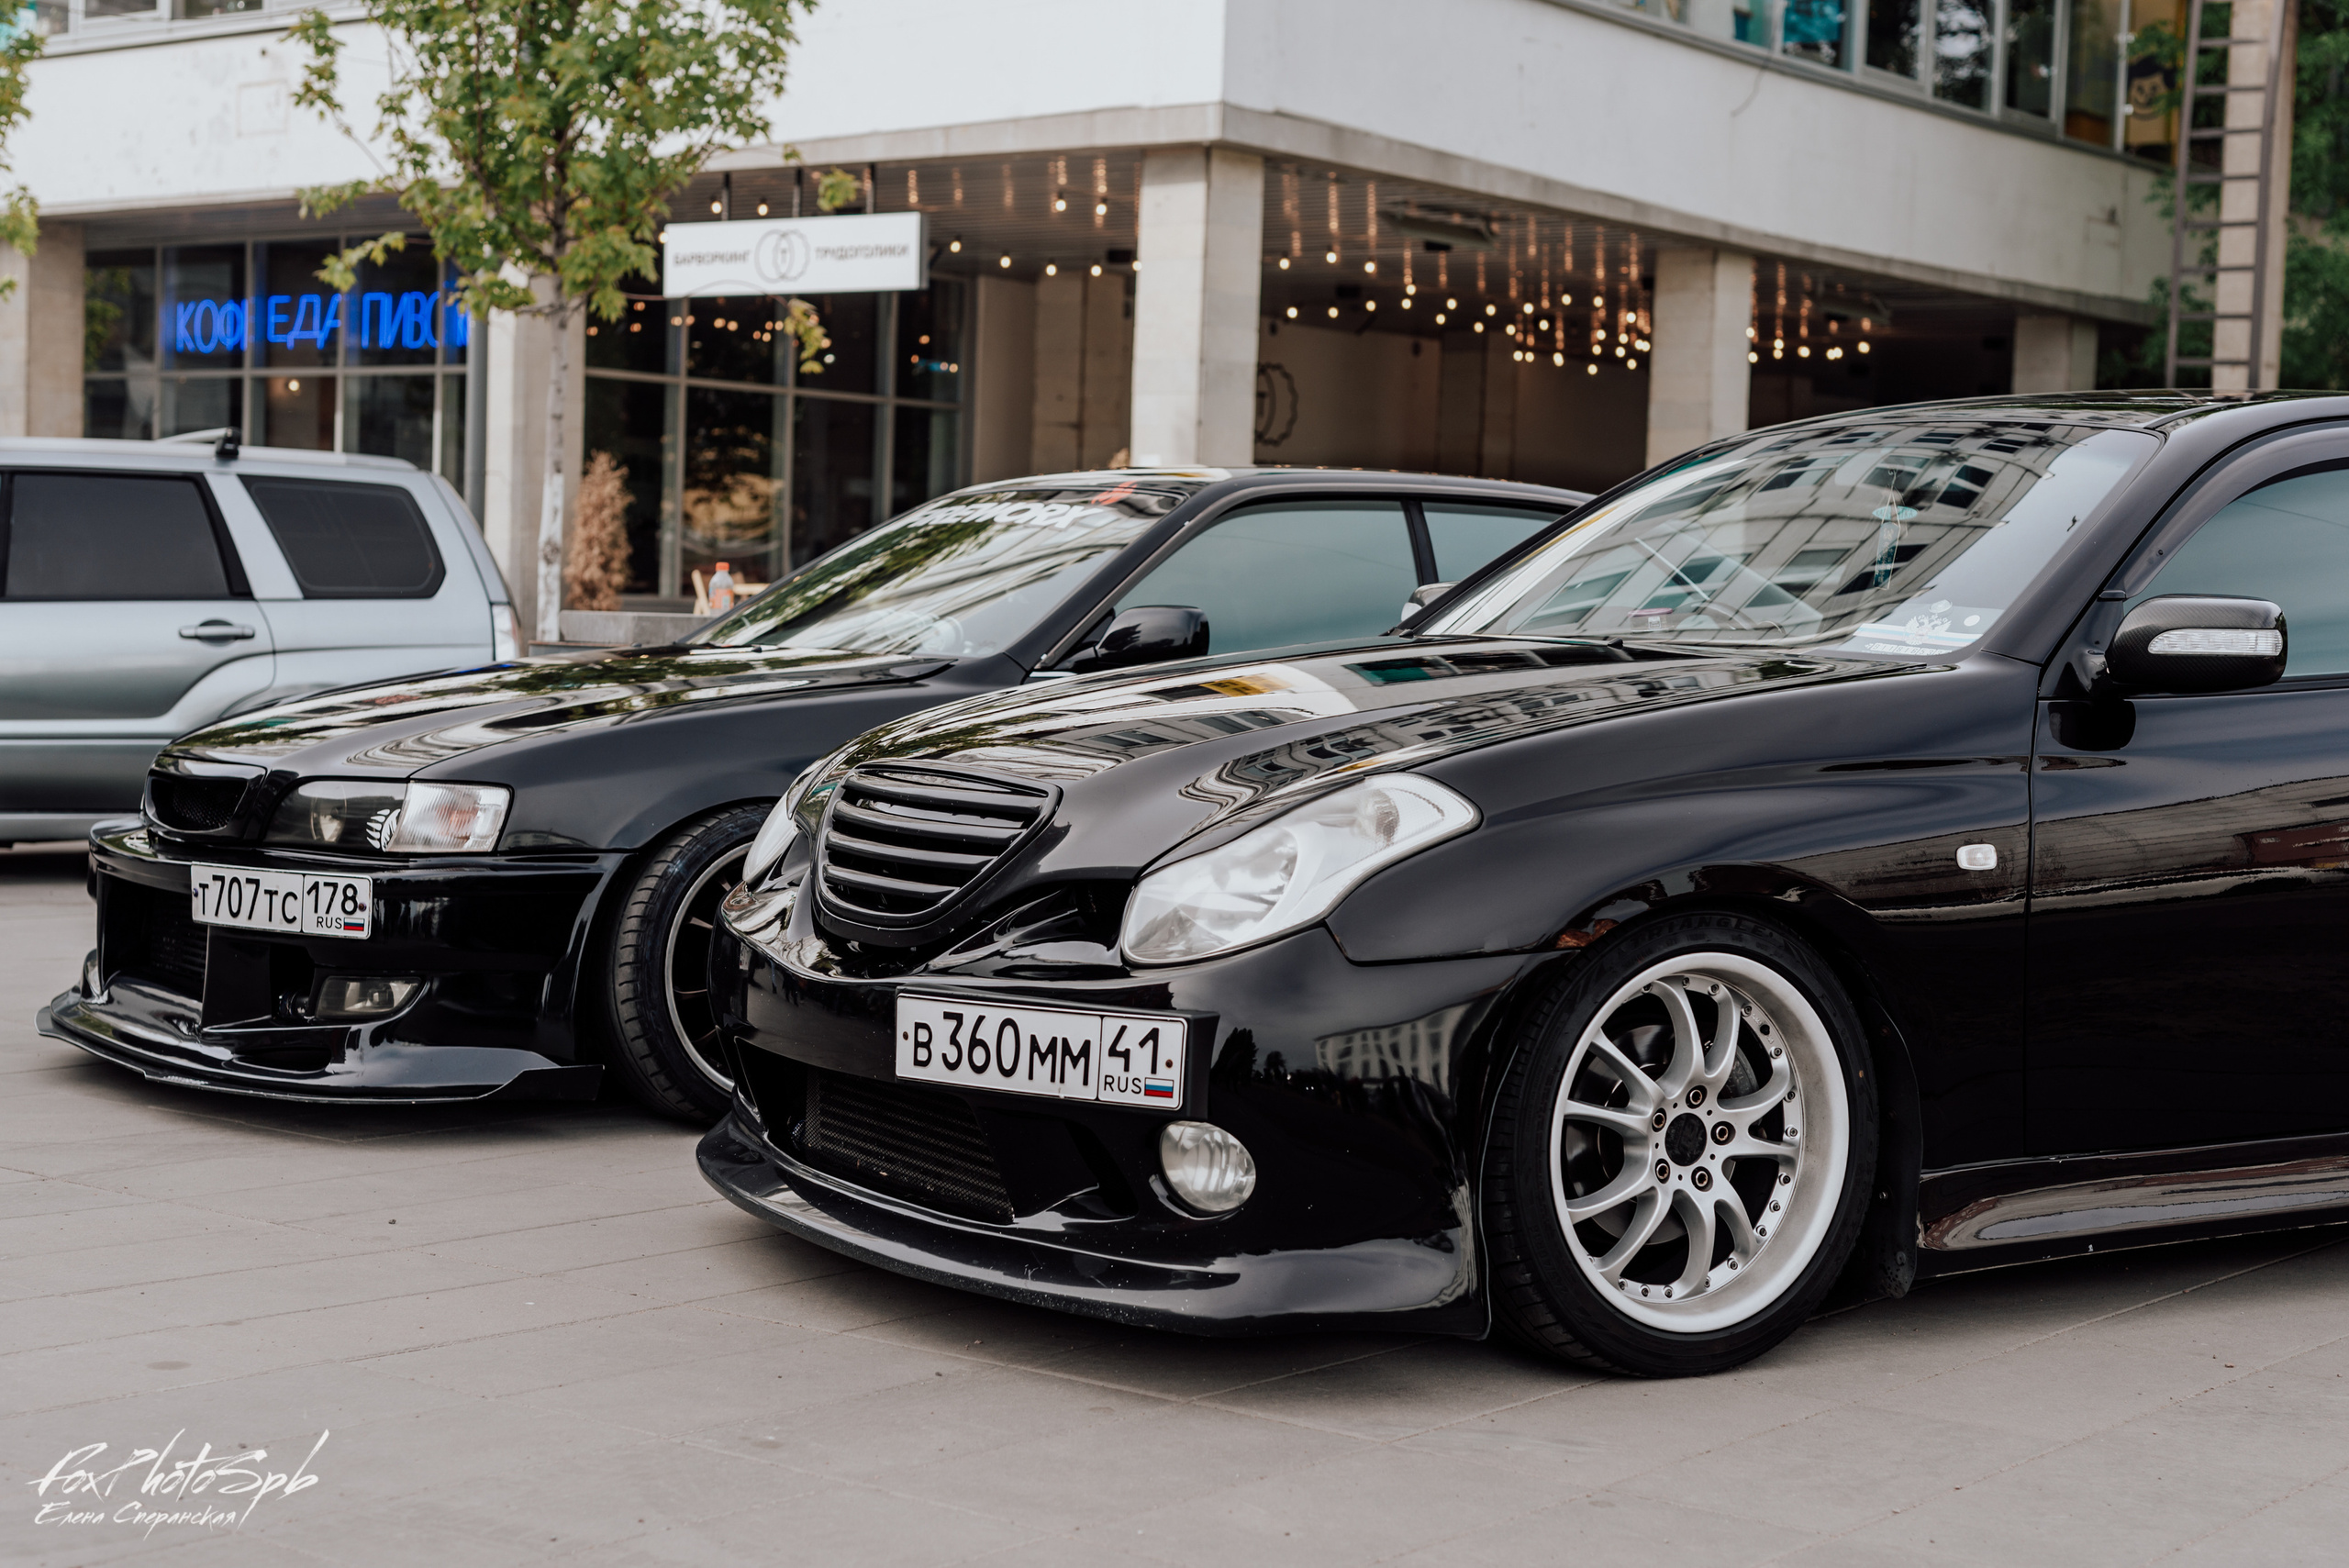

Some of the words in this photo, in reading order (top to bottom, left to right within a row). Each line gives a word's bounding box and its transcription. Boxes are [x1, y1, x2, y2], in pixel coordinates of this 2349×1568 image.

[198, 873, 299, 925] Т707ТС
[306, 880, 359, 916] 178
[316, 916, 342, 929] RUS
[913, 1010, 1092, 1086] В360ММ
[1107, 1024, 1160, 1075] 41
[1103, 1074, 1142, 1095] RUS
